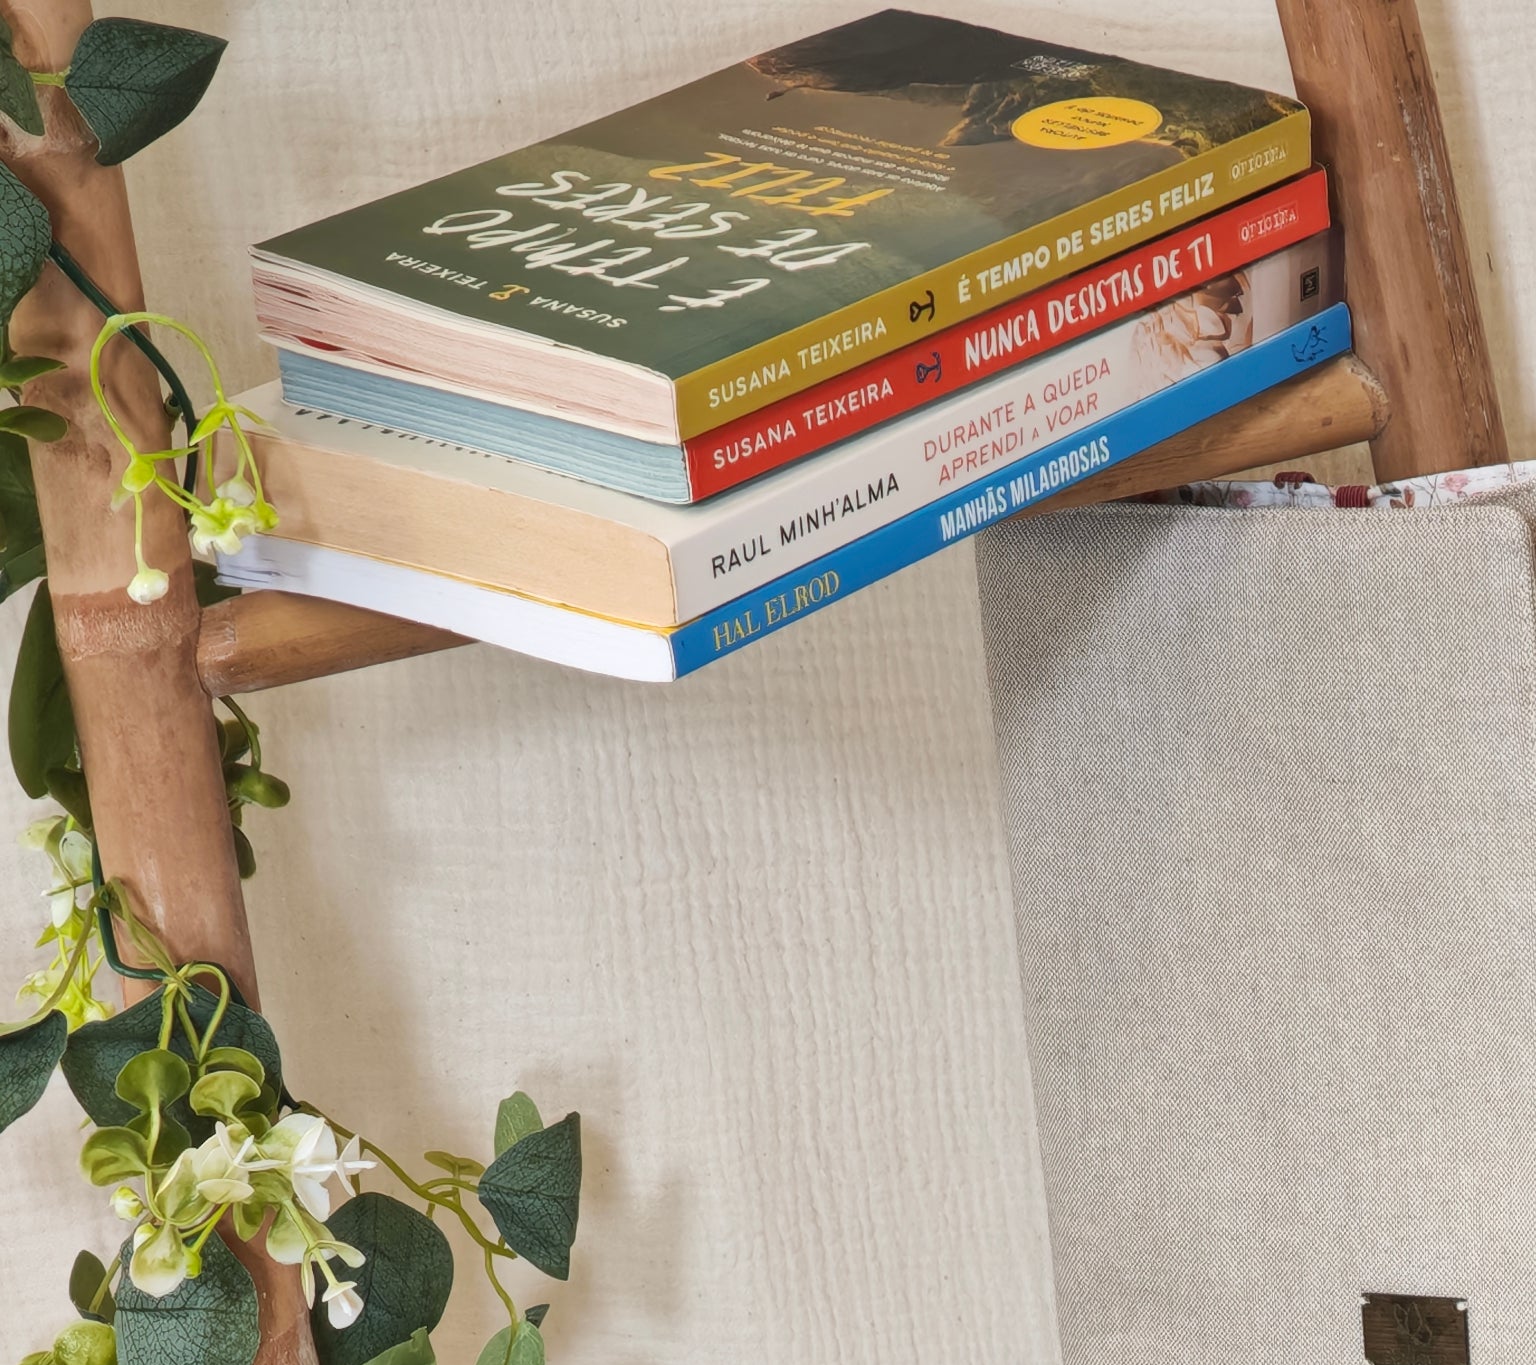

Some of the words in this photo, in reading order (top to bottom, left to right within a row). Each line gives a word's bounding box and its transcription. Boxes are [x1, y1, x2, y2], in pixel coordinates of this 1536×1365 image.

[494, 170, 749, 241] SERES
[647, 151, 895, 217] FELIZ
[384, 250, 489, 291] TEIXEIRA
[421, 209, 689, 291] TEMPO
[717, 227, 873, 272] DE
[528, 295, 628, 330] SUSANA
[658, 277, 770, 313] É
[708, 360, 792, 409] SUSANA
[797, 316, 888, 366] TEIXEIRA
[957, 274, 972, 304] É
[975, 245, 1051, 298] TEMPO
[1056, 232, 1084, 263] DE
[1090, 198, 1155, 247] SERES
[1158, 171, 1215, 217] FELIZ
[712, 420, 796, 469] SUSANA
[801, 377, 894, 427] TEIXEIRA
[964, 308, 1041, 370] NUNCA
[1047, 262, 1145, 333] DESISTAS
[1151, 244, 1183, 288] DE
[1186, 232, 1215, 269] TI
[923, 405, 1016, 462] DURANTE
[1022, 392, 1035, 416] A
[1042, 356, 1112, 404] QUEDA
[937, 428, 1025, 485] APRENDI
[1046, 392, 1100, 438] VOAR
[711, 536, 771, 579] RAUL
[712, 603, 761, 652] HAL
[764, 569, 841, 631] ELROD
[939, 488, 1007, 542] MANHÃS
[1010, 433, 1110, 510] MILAGROSAS
